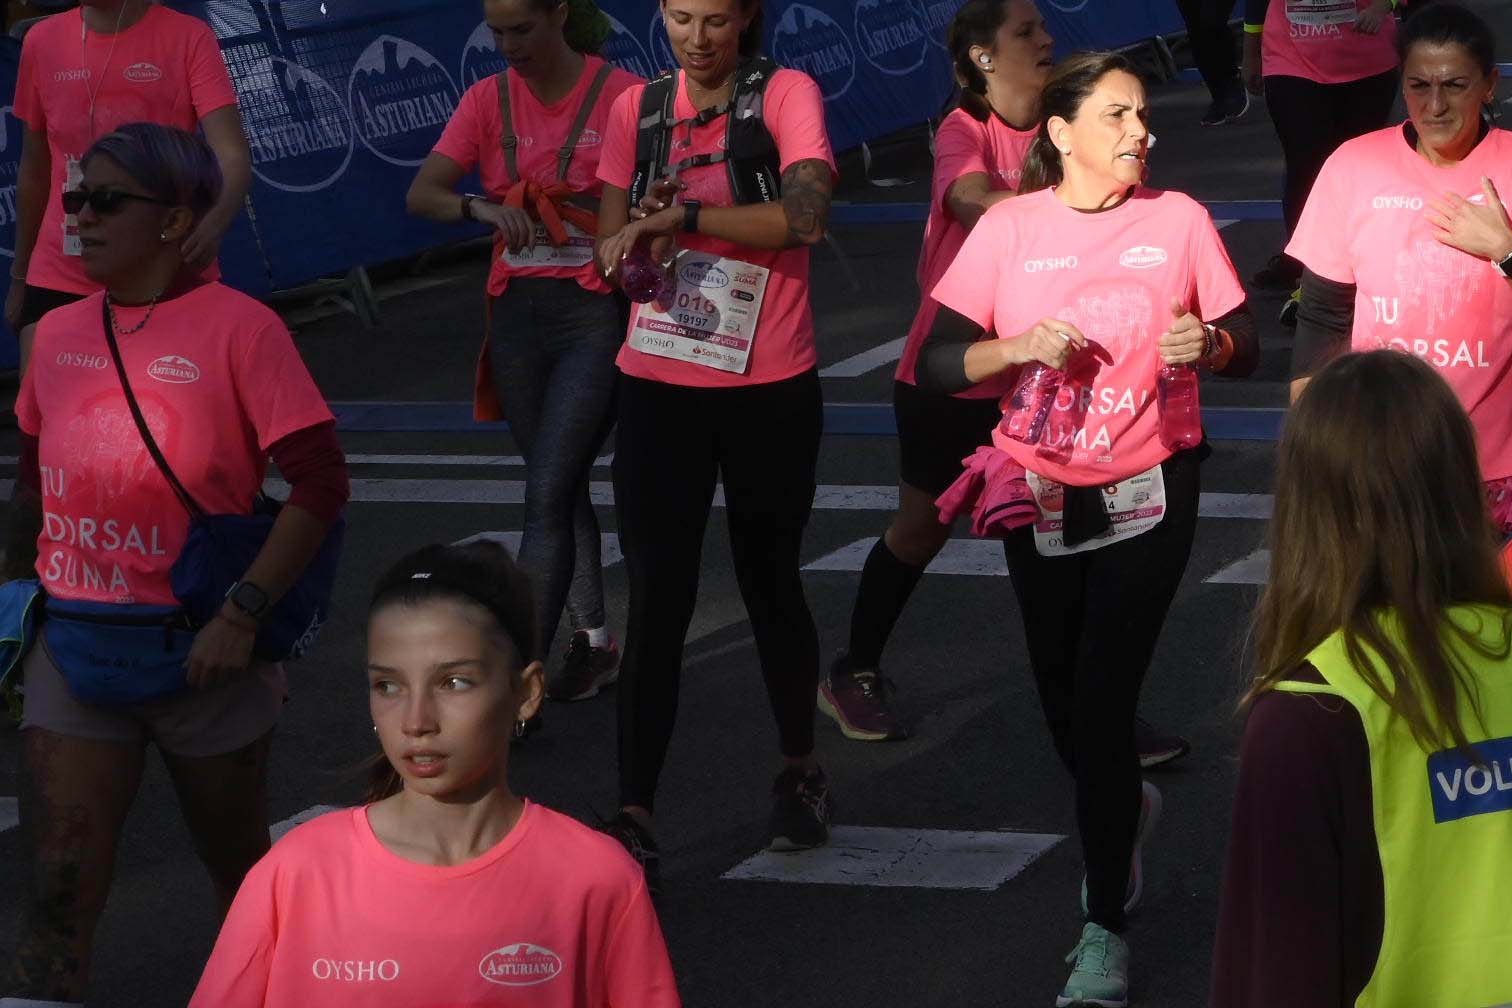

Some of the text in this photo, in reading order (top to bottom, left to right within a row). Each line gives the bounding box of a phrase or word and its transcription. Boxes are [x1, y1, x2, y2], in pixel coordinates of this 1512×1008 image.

[1289, 23, 1340, 37] SUMA
[54, 68, 91, 81] OYSHO
[361, 92, 455, 139] ASTURIANA
[1372, 195, 1423, 211] OYSHO
[1024, 255, 1078, 273] OYSHO
[678, 293, 716, 314] 016
[1373, 295, 1399, 325] TU
[649, 321, 678, 333] CARRERA
[678, 312, 709, 328] 19197
[641, 335, 738, 363] OYSHO Santander
[56, 351, 108, 370] OYSHO
[150, 363, 196, 381] ASTURIANA
[41, 466, 65, 497] TU
[45, 550, 129, 592] SUMA
[312, 958, 400, 982] OYSHO
[487, 960, 555, 976] ASTURIANA
